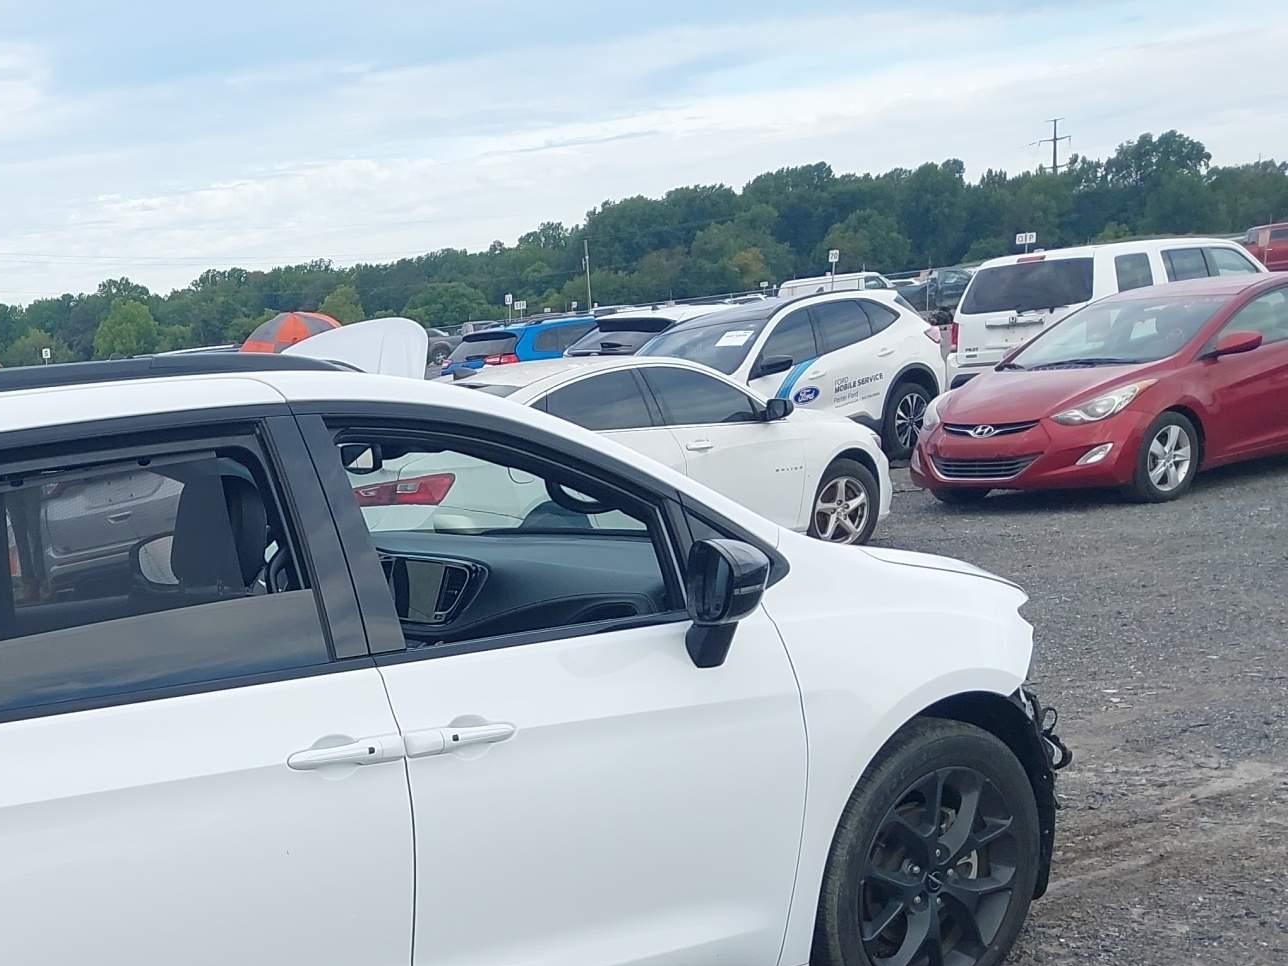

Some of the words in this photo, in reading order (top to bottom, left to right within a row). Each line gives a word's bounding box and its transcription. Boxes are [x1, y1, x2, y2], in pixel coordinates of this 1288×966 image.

[834, 380, 857, 393] MOBILE
[857, 373, 884, 387] SERVICE
[796, 388, 817, 403] Ford
